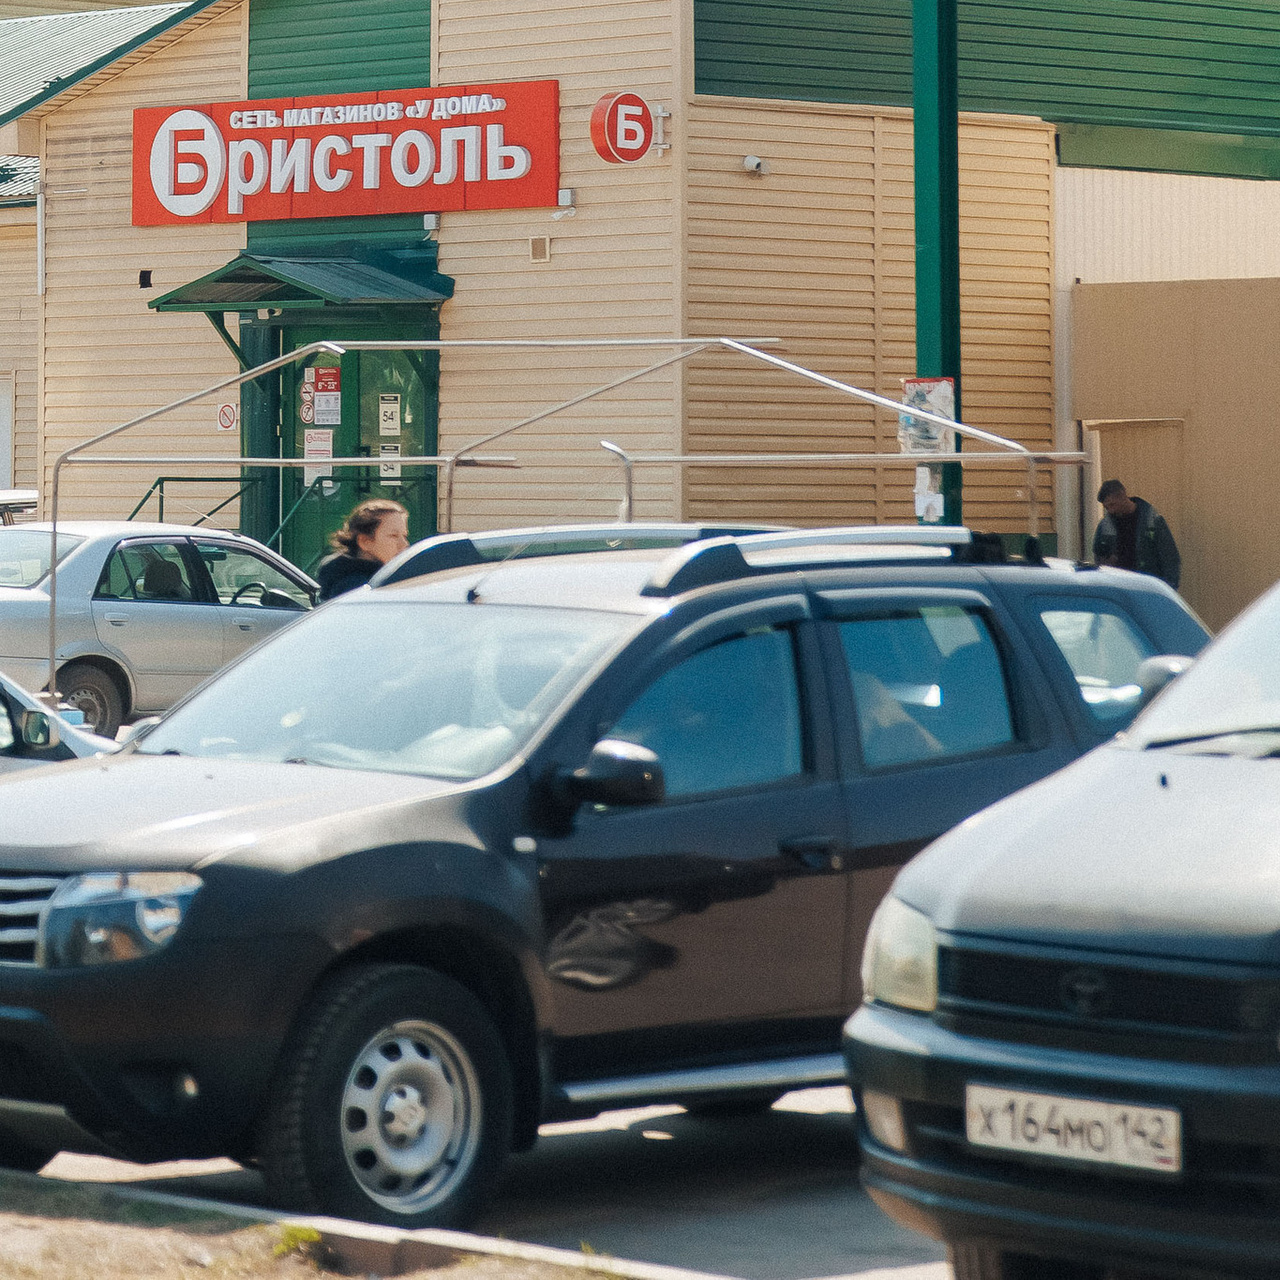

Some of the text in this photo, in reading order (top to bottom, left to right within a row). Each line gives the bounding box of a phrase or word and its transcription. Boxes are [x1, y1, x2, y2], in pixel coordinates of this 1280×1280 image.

[229, 110, 282, 129] СЕТЬ
[283, 101, 404, 128] МАГАЗИНОВ
[616, 104, 645, 150] Б
[979, 1098, 1166, 1152] Х164МО 142
